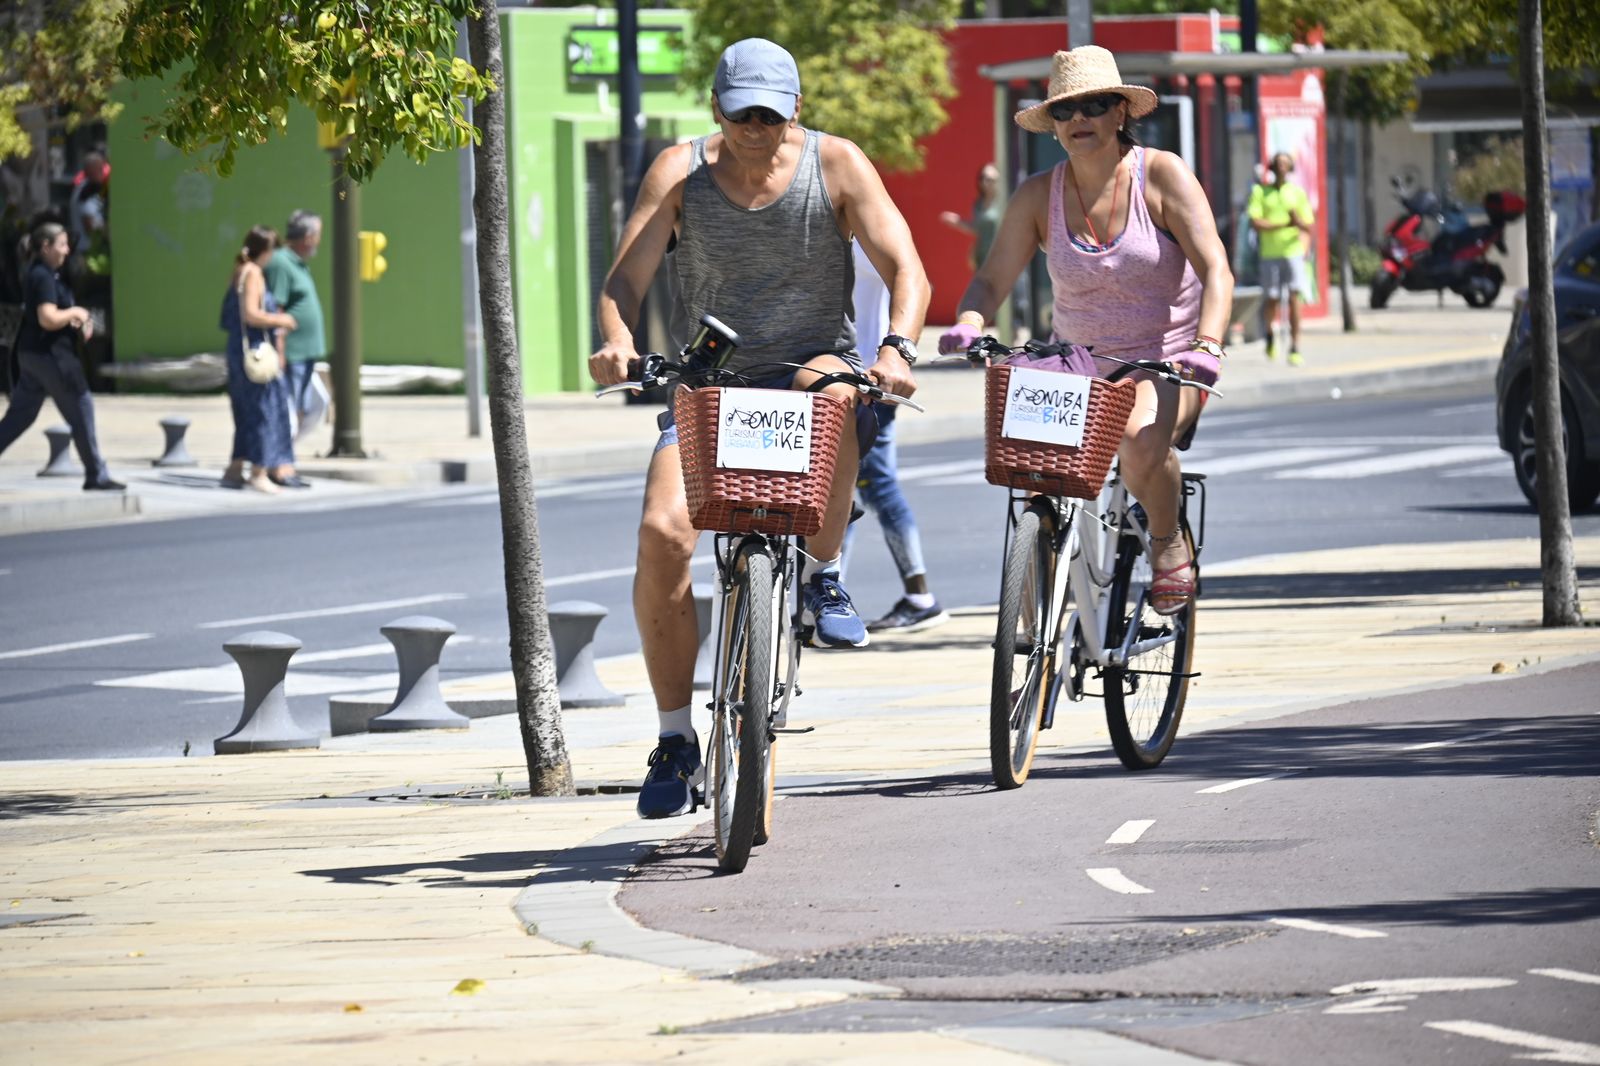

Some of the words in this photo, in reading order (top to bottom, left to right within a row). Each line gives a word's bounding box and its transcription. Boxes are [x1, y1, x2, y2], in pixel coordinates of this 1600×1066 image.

[1032, 389, 1083, 411] ONUBA
[749, 409, 806, 431] ONUBA
[725, 428, 762, 439] TURISMO
